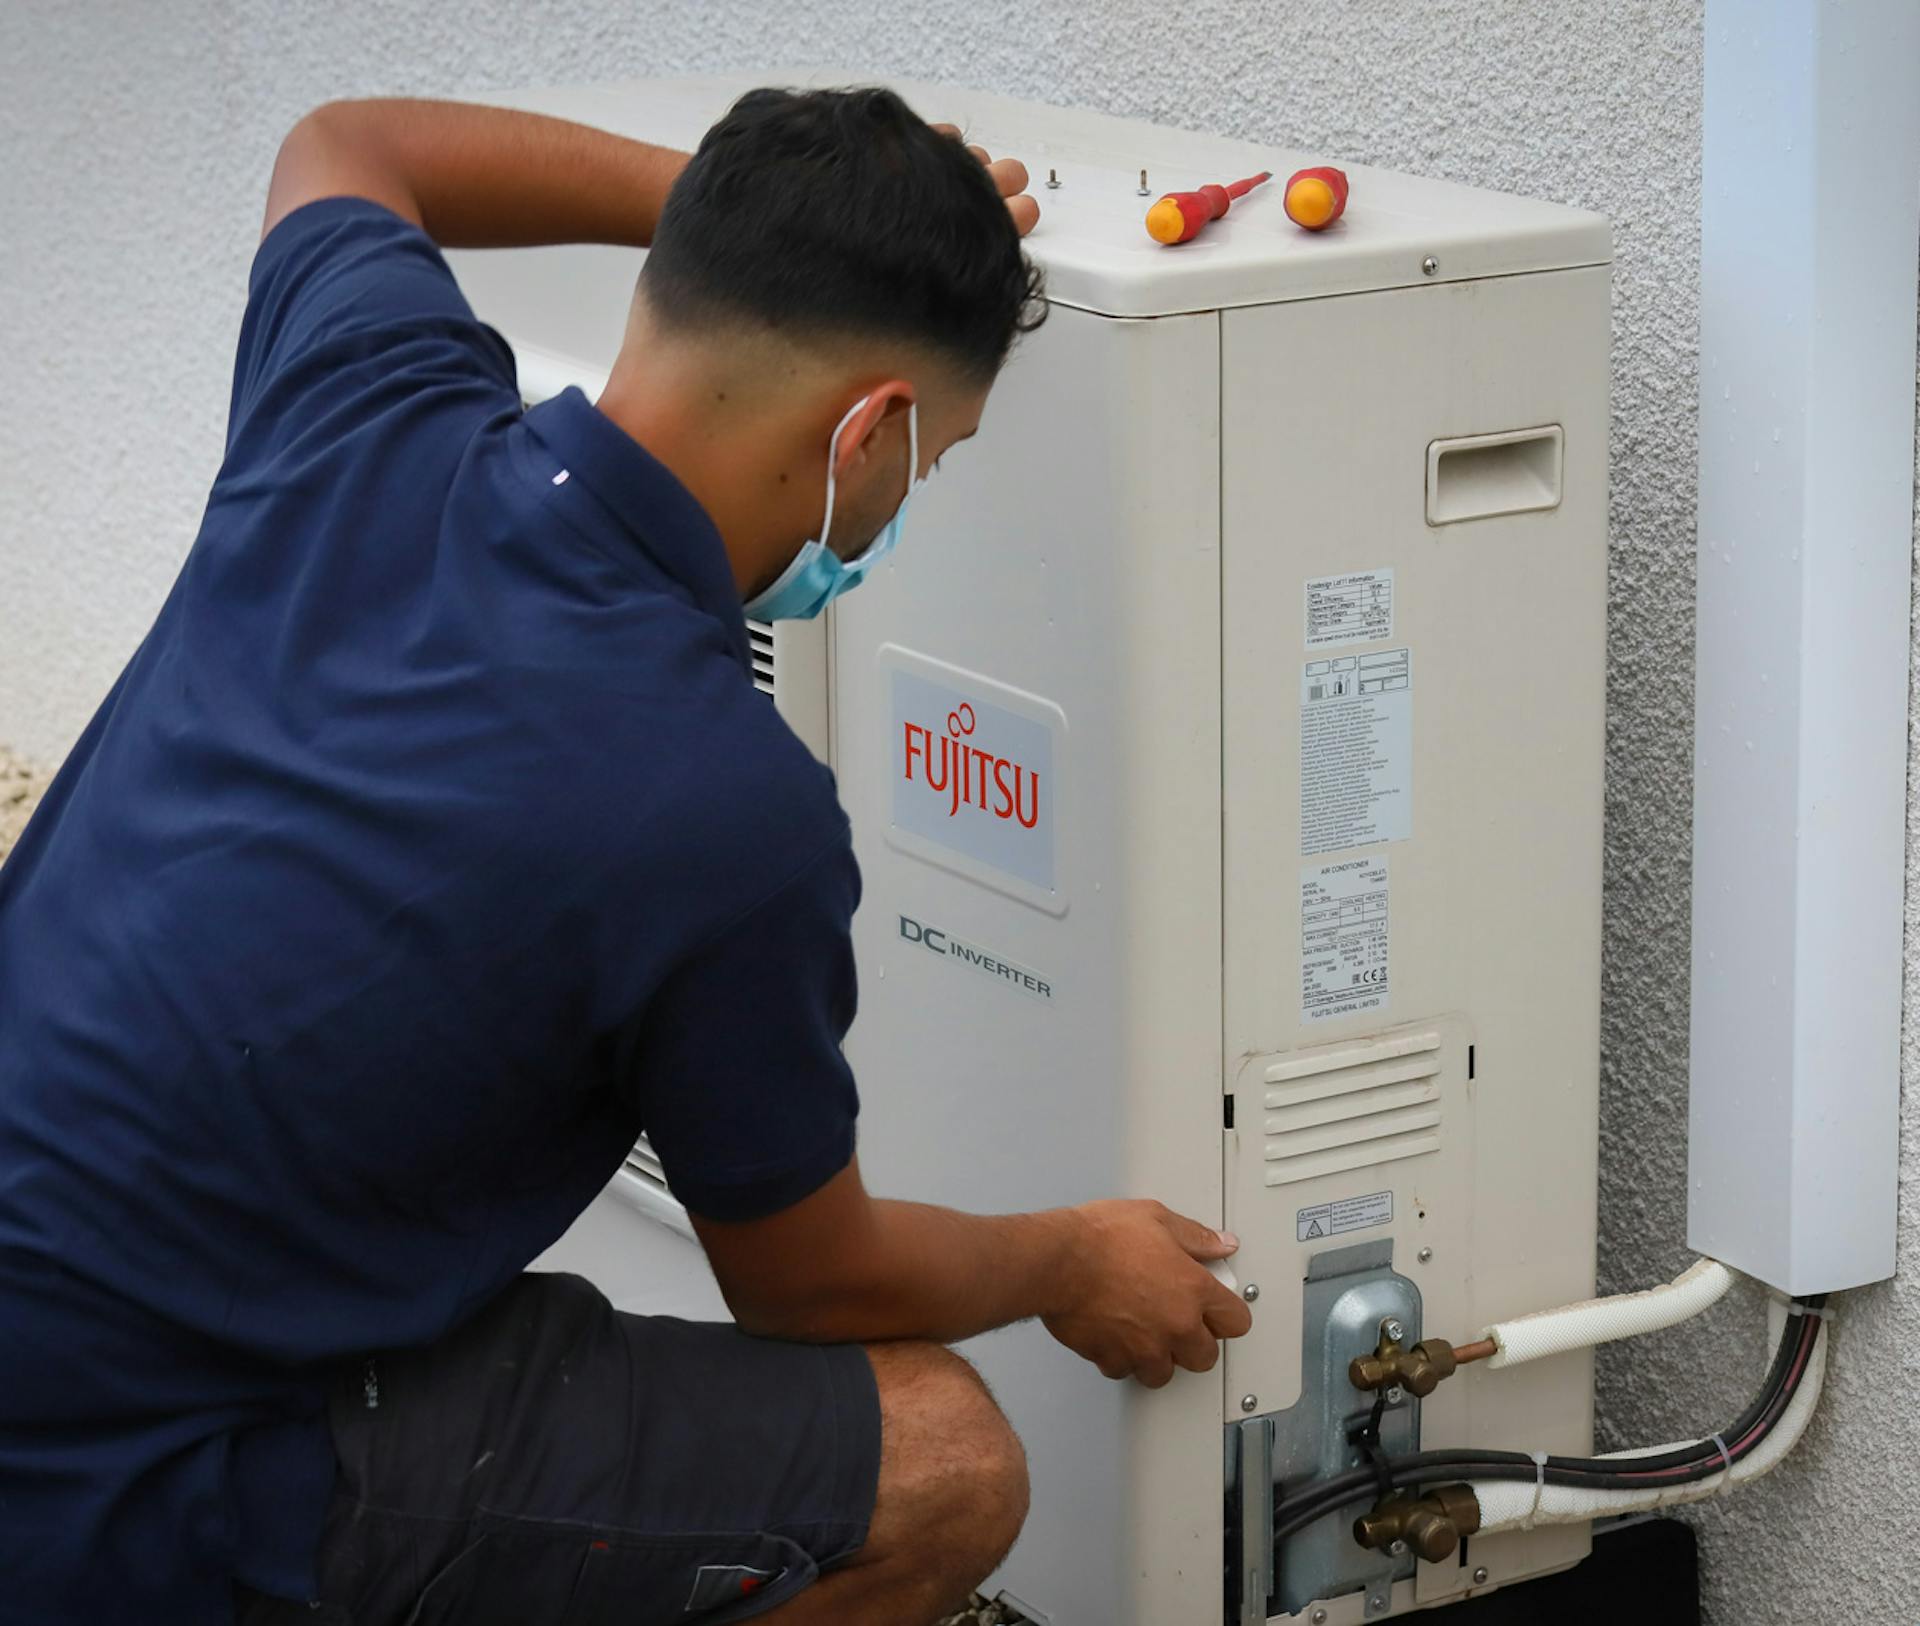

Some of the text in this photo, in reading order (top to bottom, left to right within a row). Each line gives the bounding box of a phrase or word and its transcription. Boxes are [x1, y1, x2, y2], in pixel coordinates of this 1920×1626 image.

[904, 719, 1039, 829] FUJITSU
[1321, 860, 1369, 875] AIR CONDITIONER
[899, 914, 1052, 998] DC INVERTER
[1333, 1002, 1359, 1015] GENERAL
[1359, 998, 1380, 1009] LIMITED
